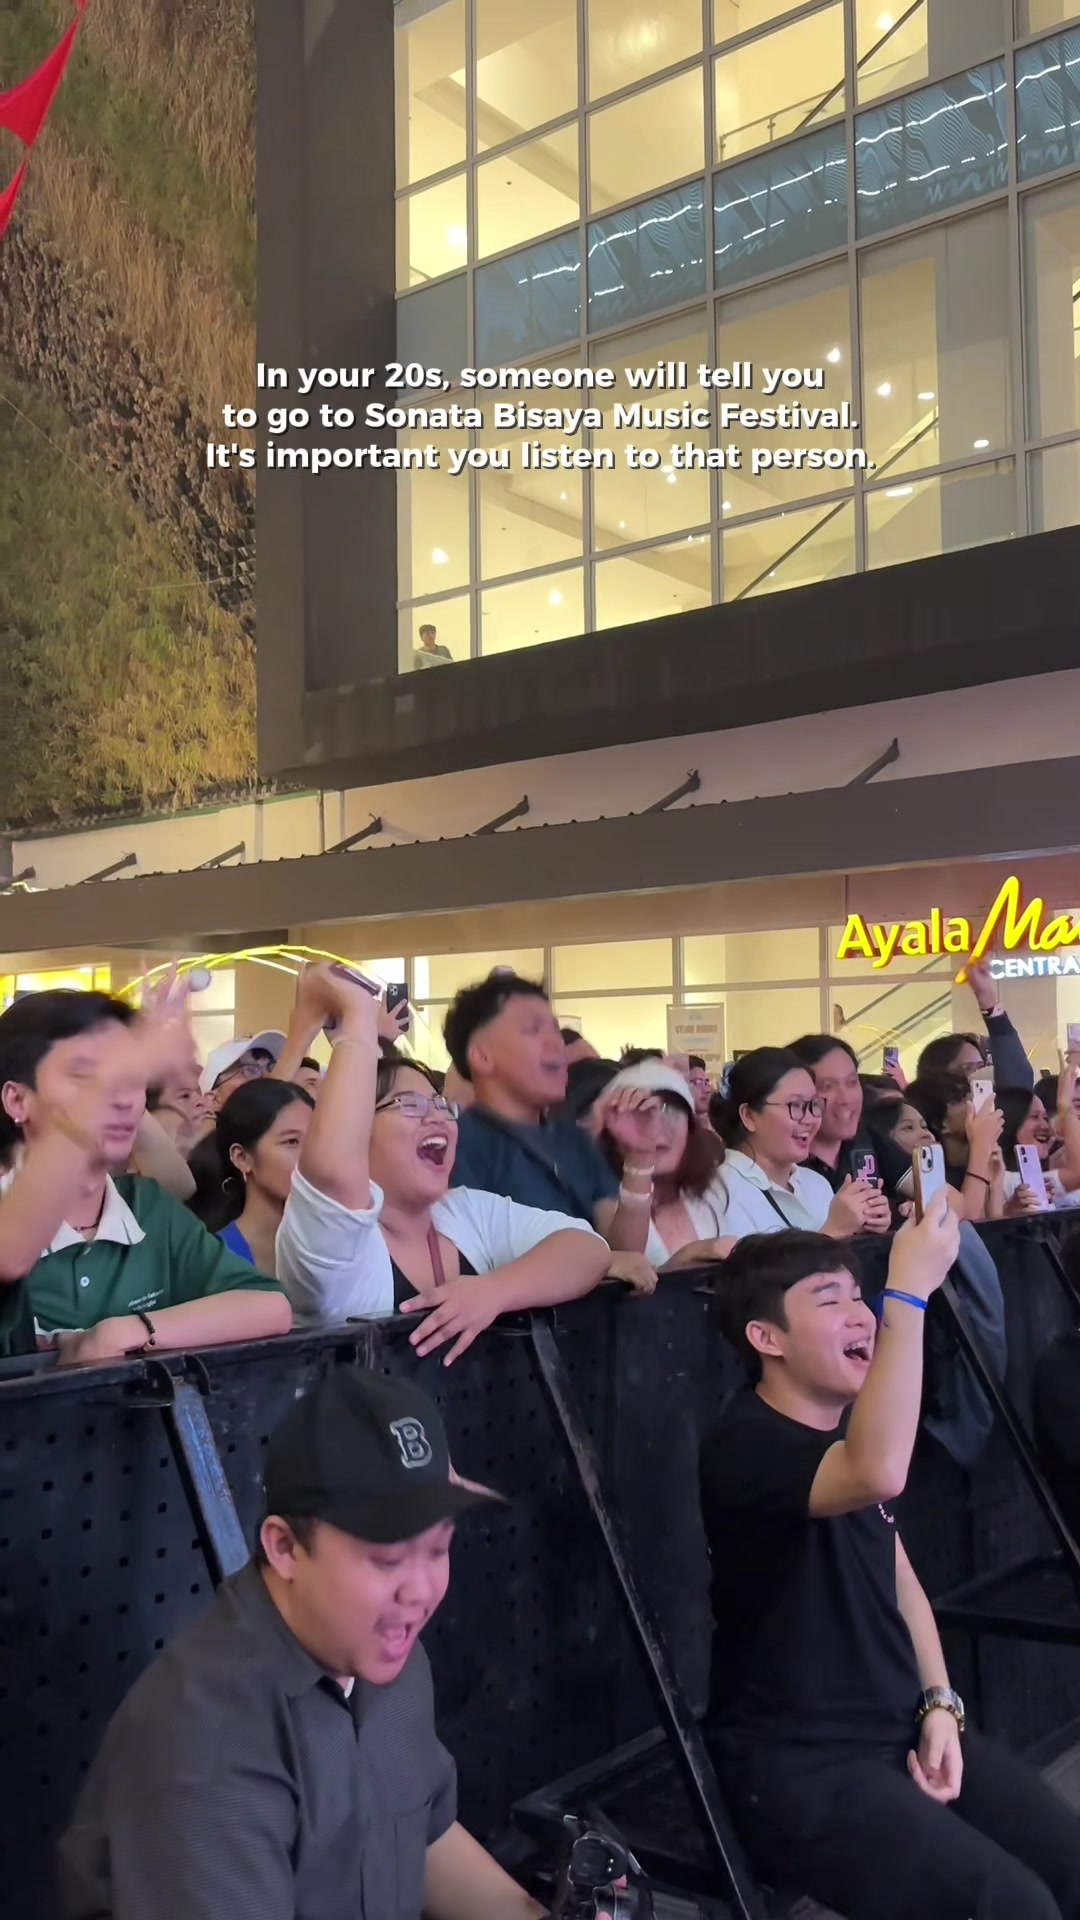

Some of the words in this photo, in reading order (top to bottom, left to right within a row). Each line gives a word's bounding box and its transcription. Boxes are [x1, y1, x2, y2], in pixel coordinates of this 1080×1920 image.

[836, 907, 970, 969] Ayala
[953, 875, 1080, 985] Ma
[989, 956, 1080, 979] CENTRA
[389, 1416, 433, 1468] B
